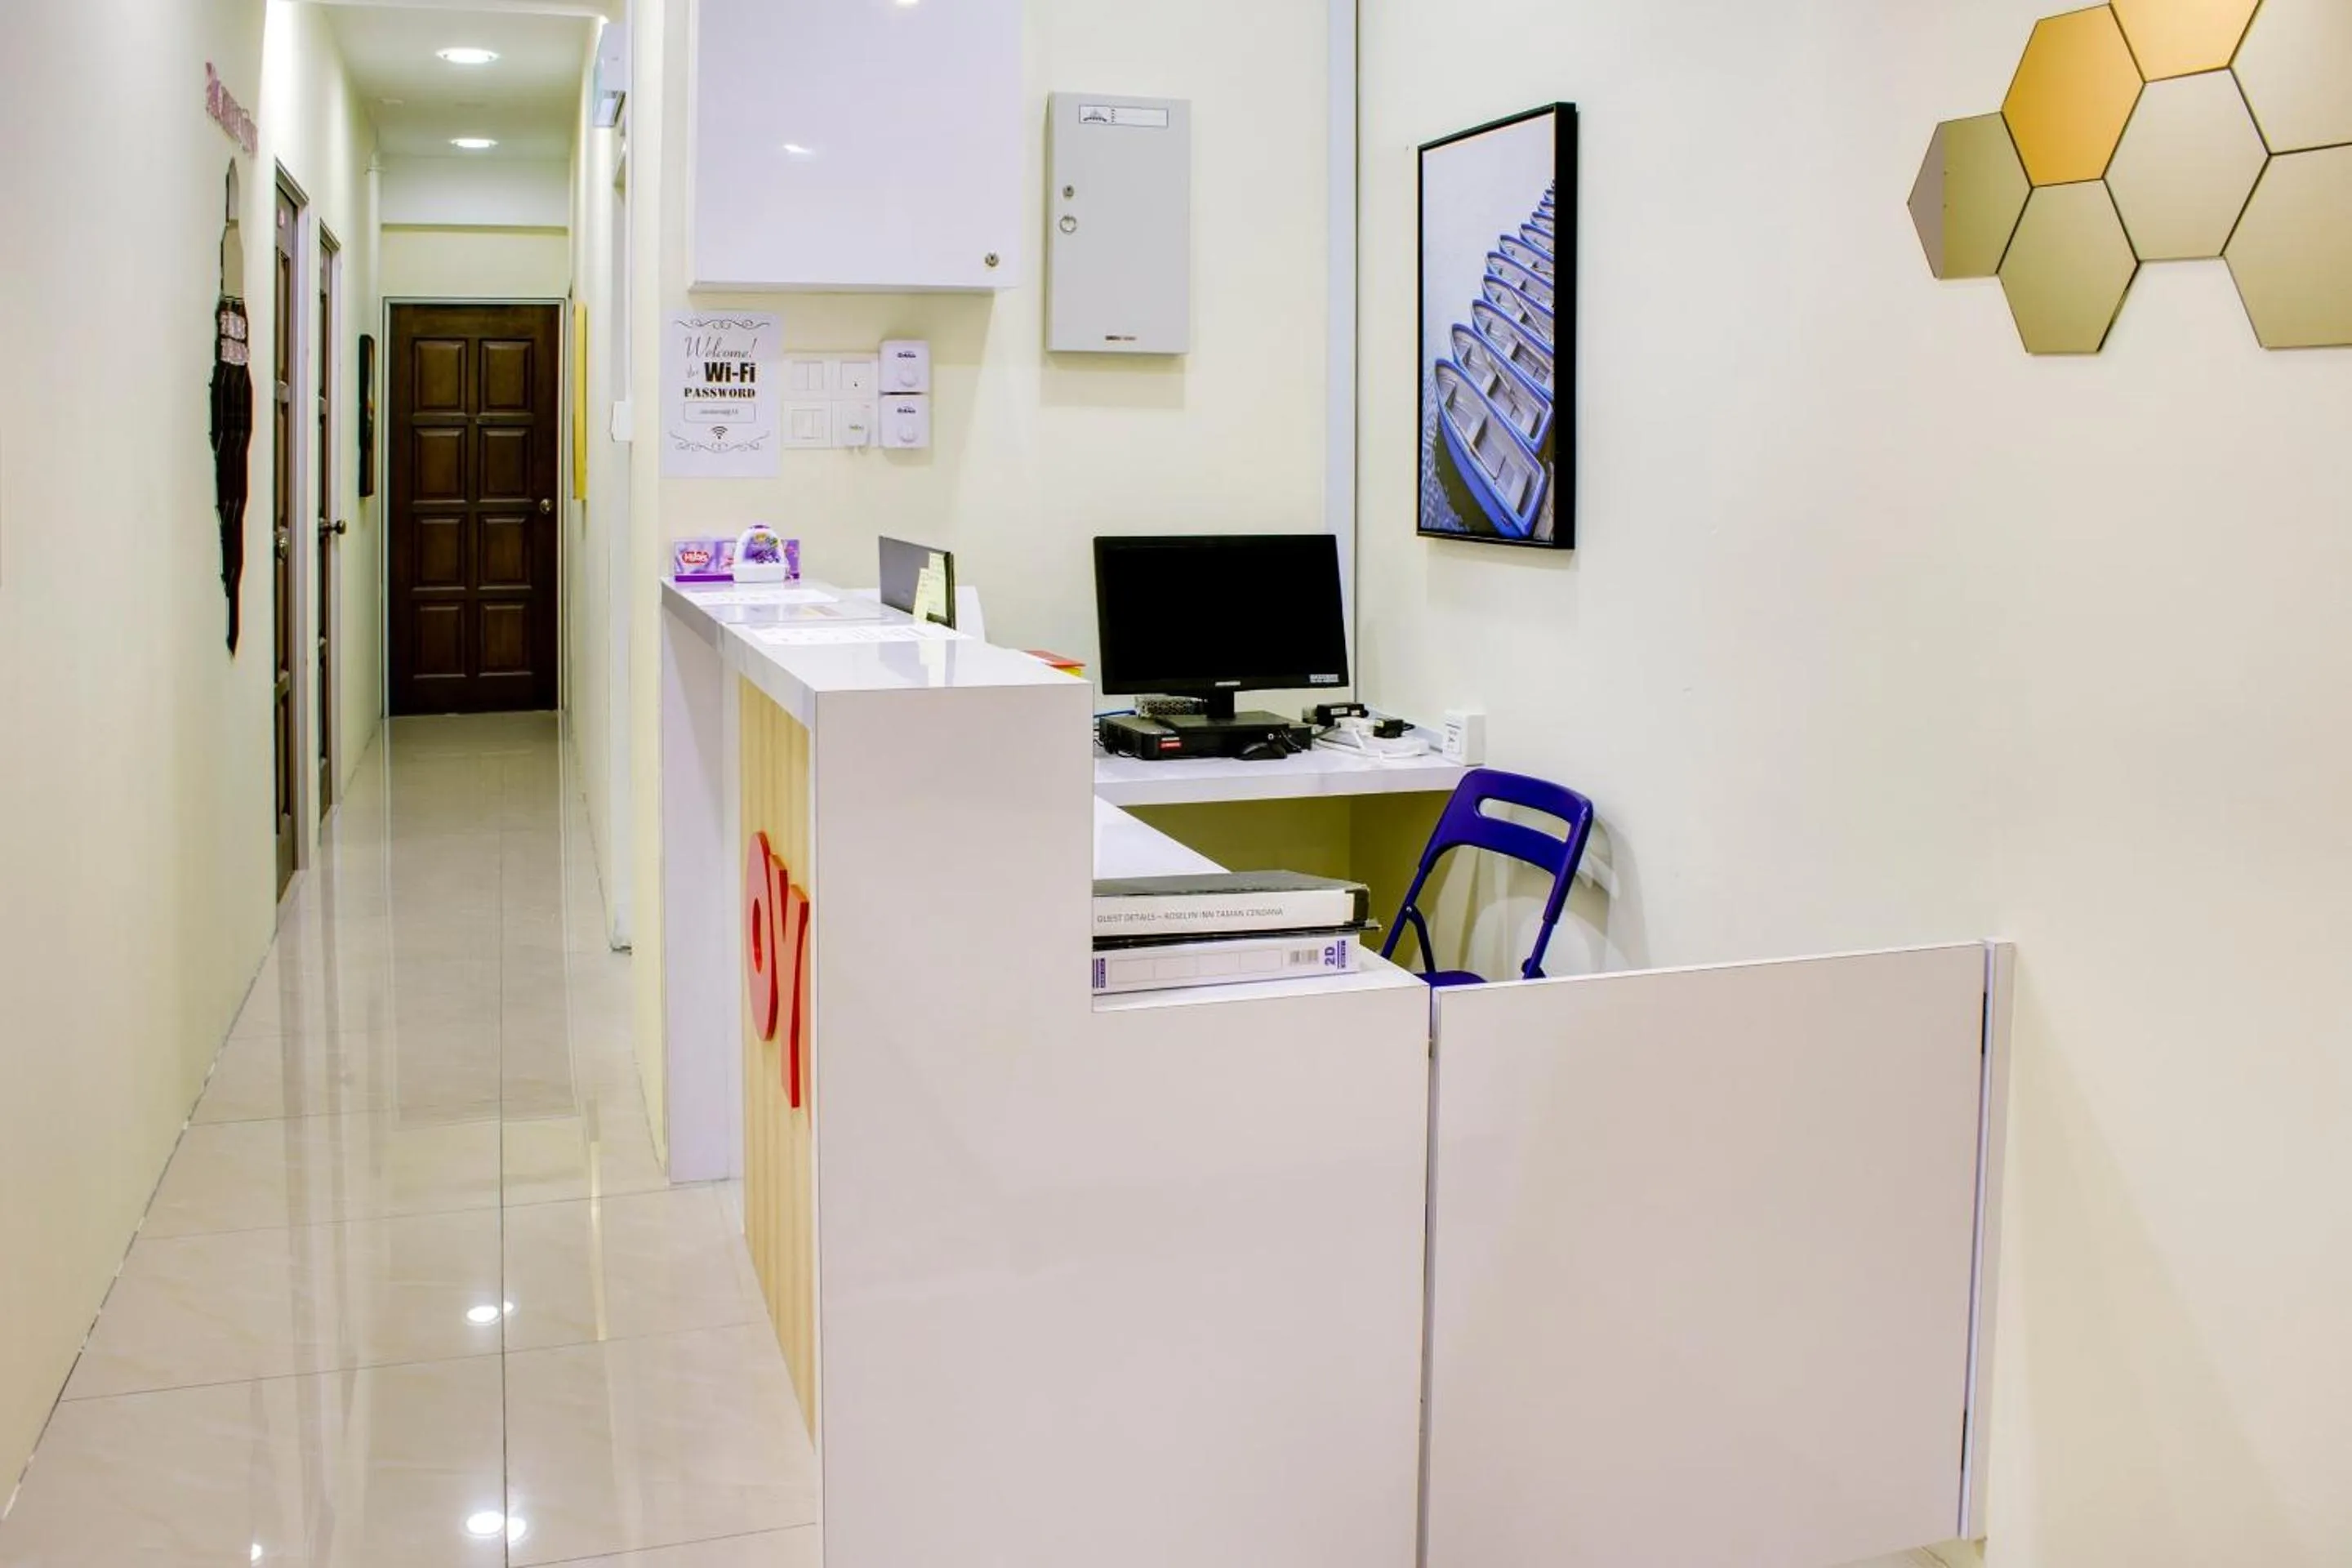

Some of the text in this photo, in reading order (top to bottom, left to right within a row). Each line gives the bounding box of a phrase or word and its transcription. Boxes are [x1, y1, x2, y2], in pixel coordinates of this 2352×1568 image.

[684, 336, 758, 359] Welcome!
[704, 362, 756, 383] Wi-Fi
[684, 387, 755, 398] PASSWORD
[1097, 915, 1121, 923] GUEST
[1124, 913, 1156, 922] DETAILS
[1164, 911, 1198, 920] ROSELYN
[1199, 911, 1214, 919] INN
[1216, 909, 1244, 917] TAMAN
[1245, 907, 1283, 916] CENDANA
[1325, 947, 1335, 966] 2D
